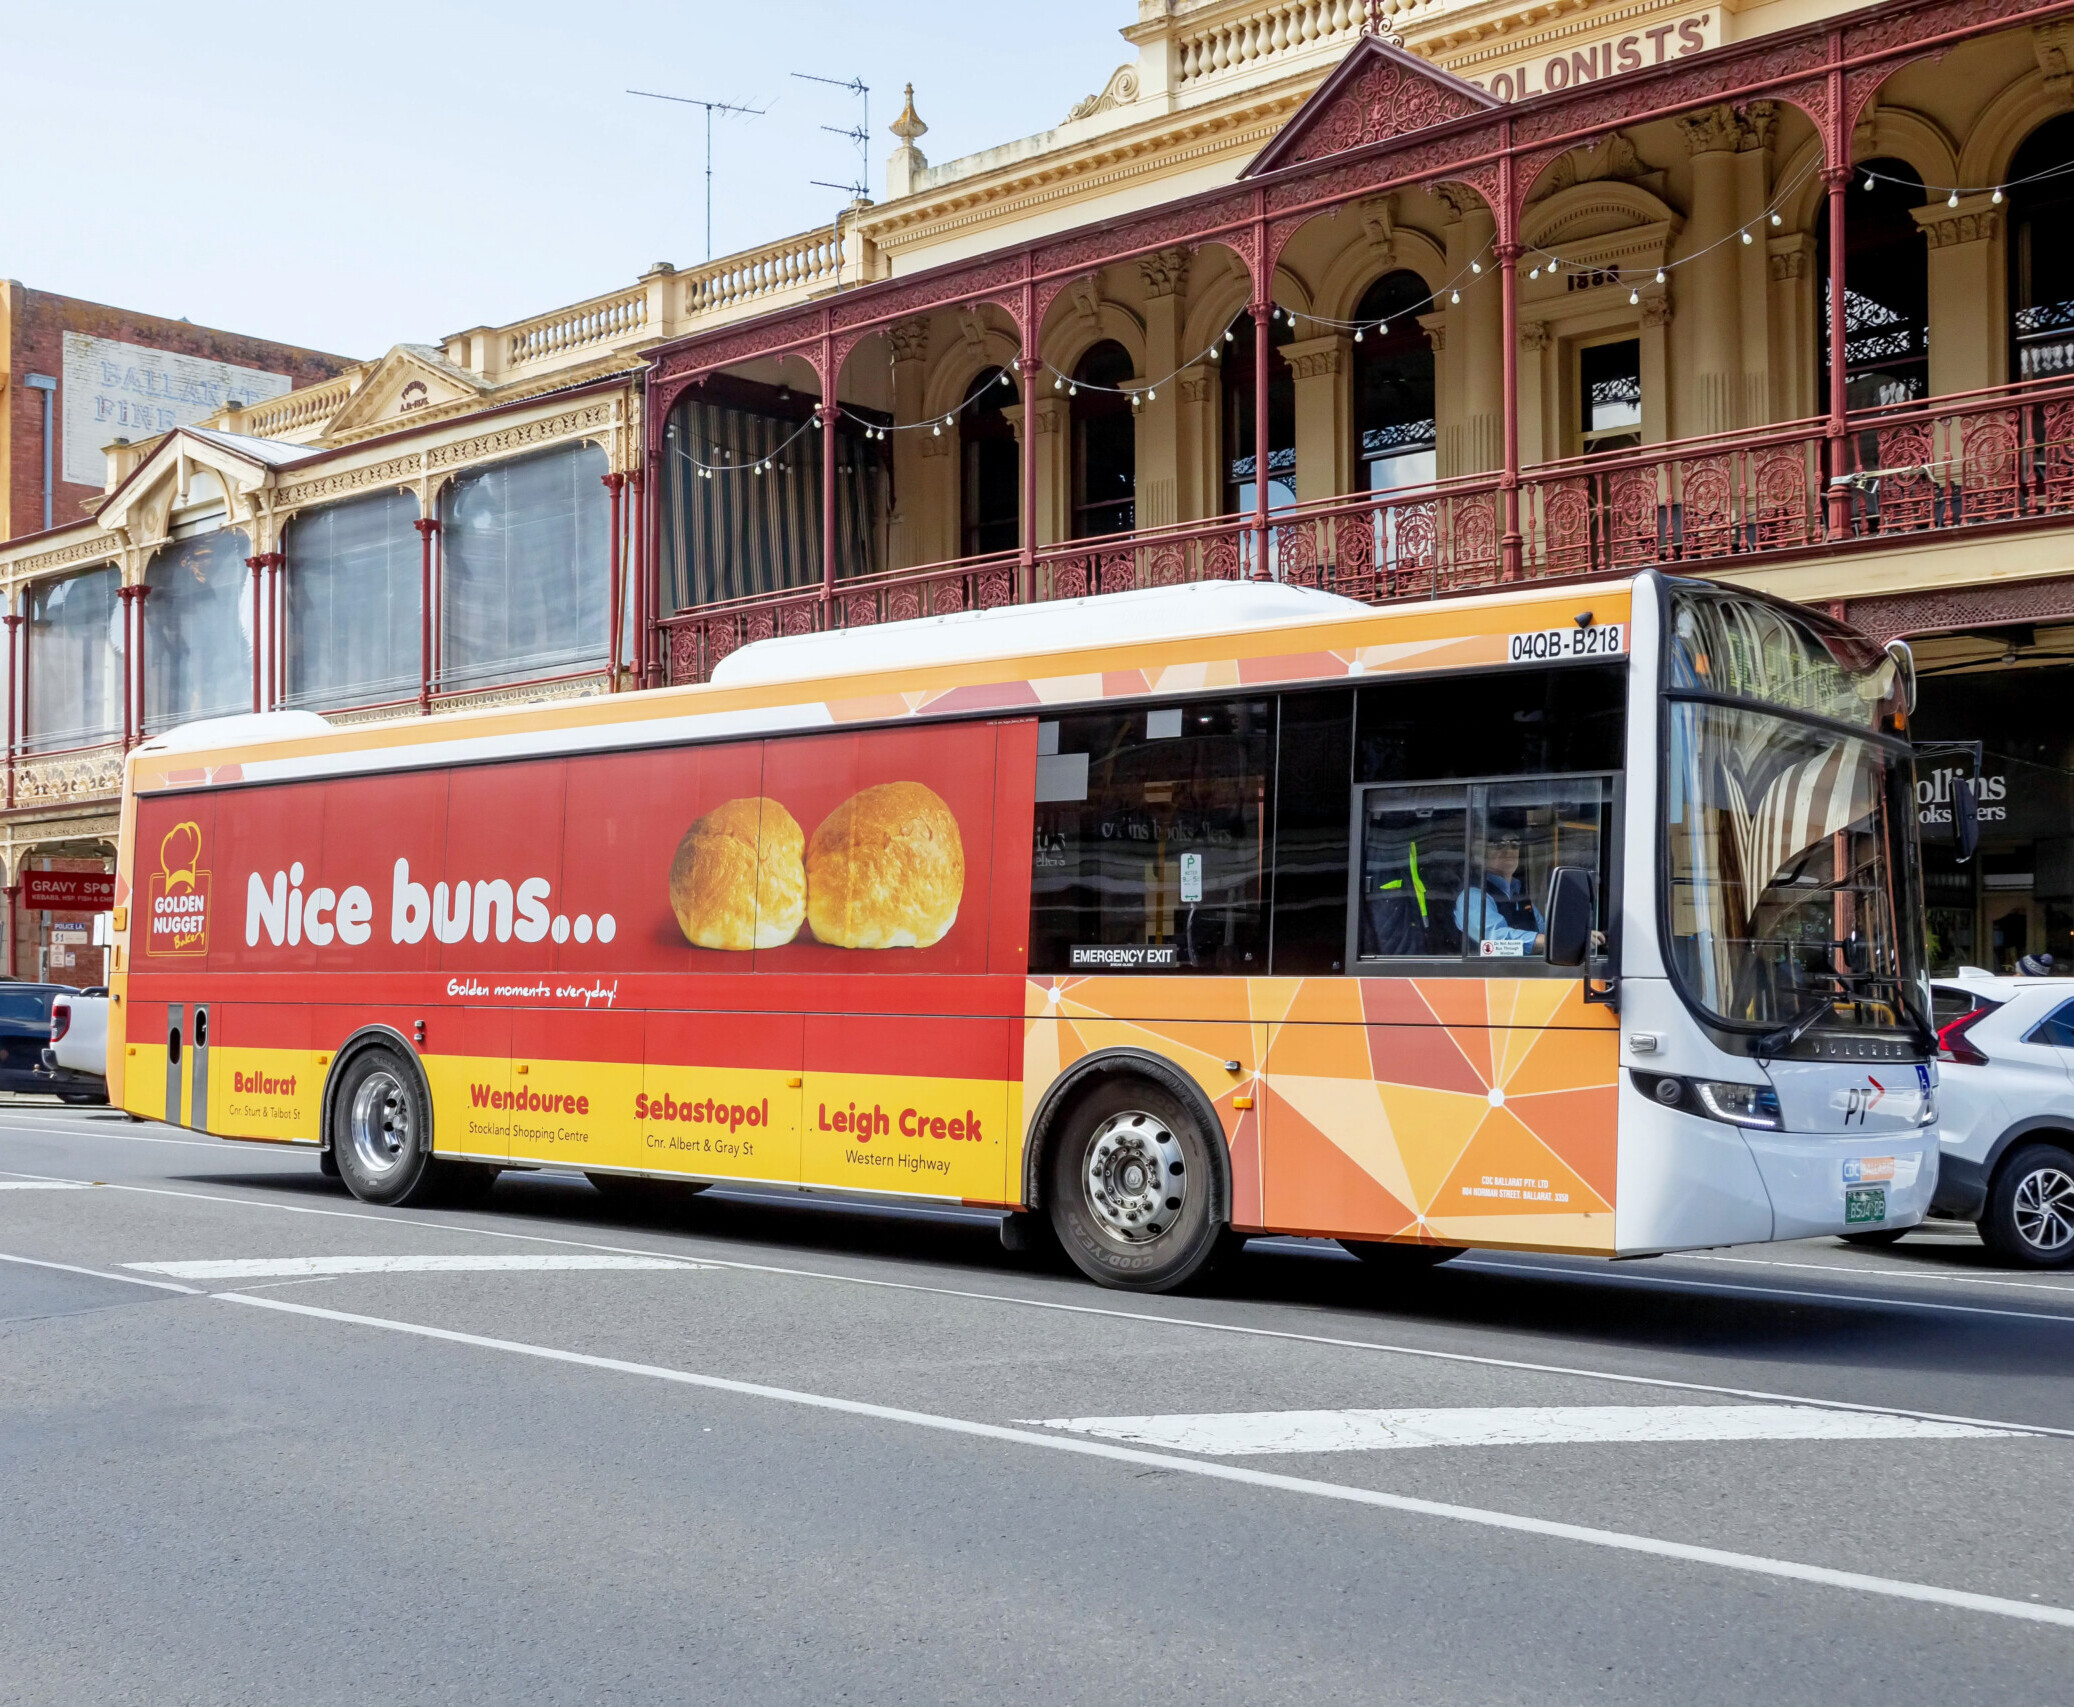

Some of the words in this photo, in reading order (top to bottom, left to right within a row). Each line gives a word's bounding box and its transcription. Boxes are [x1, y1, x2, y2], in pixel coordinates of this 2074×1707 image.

[1470, 14, 1710, 104] OLONISTS'
[1512, 626, 1619, 661] 04QB-B218
[1187, 857, 1195, 869] P
[31, 880, 77, 893] GRAVY
[155, 895, 204, 913] GOLDEN
[245, 861, 373, 947] Nice
[391, 857, 616, 944] buns...
[153, 916, 205, 933] NUGGET
[174, 932, 205, 949] Bakery
[1073, 949, 1145, 963] EMERGENCY
[1147, 949, 1173, 963] EXIT
[447, 978, 489, 996] Golden
[494, 980, 551, 997] moments
[556, 979, 617, 1007] everyday!
[234, 1071, 297, 1096] Ballarat
[470, 1083, 589, 1115] Wendouree
[244, 1105, 261, 1117] Sturt
[263, 1106, 268, 1118] &
[270, 1106, 291, 1119] Talbot
[293, 1108, 301, 1120] St
[635, 1092, 768, 1134] Sebastopol
[818, 1101, 890, 1143] Leigh
[899, 1108, 982, 1142] Creek
[469, 1121, 511, 1137] Stockland
[513, 1124, 555, 1143] Shopping
[557, 1127, 589, 1143] Centre
[646, 1134, 666, 1149] Cnr.
[669, 1135, 700, 1152] Albert
[704, 1139, 712, 1152] &
[714, 1139, 739, 1158] Gray
[743, 1142, 754, 1156] St
[845, 1149, 894, 1167] Western
[898, 1153, 951, 1175] Highway
[1481, 1176, 1493, 1185] CDC
[1494, 1177, 1523, 1187] BALLARAT
[1538, 1179, 1549, 1189] LTD
